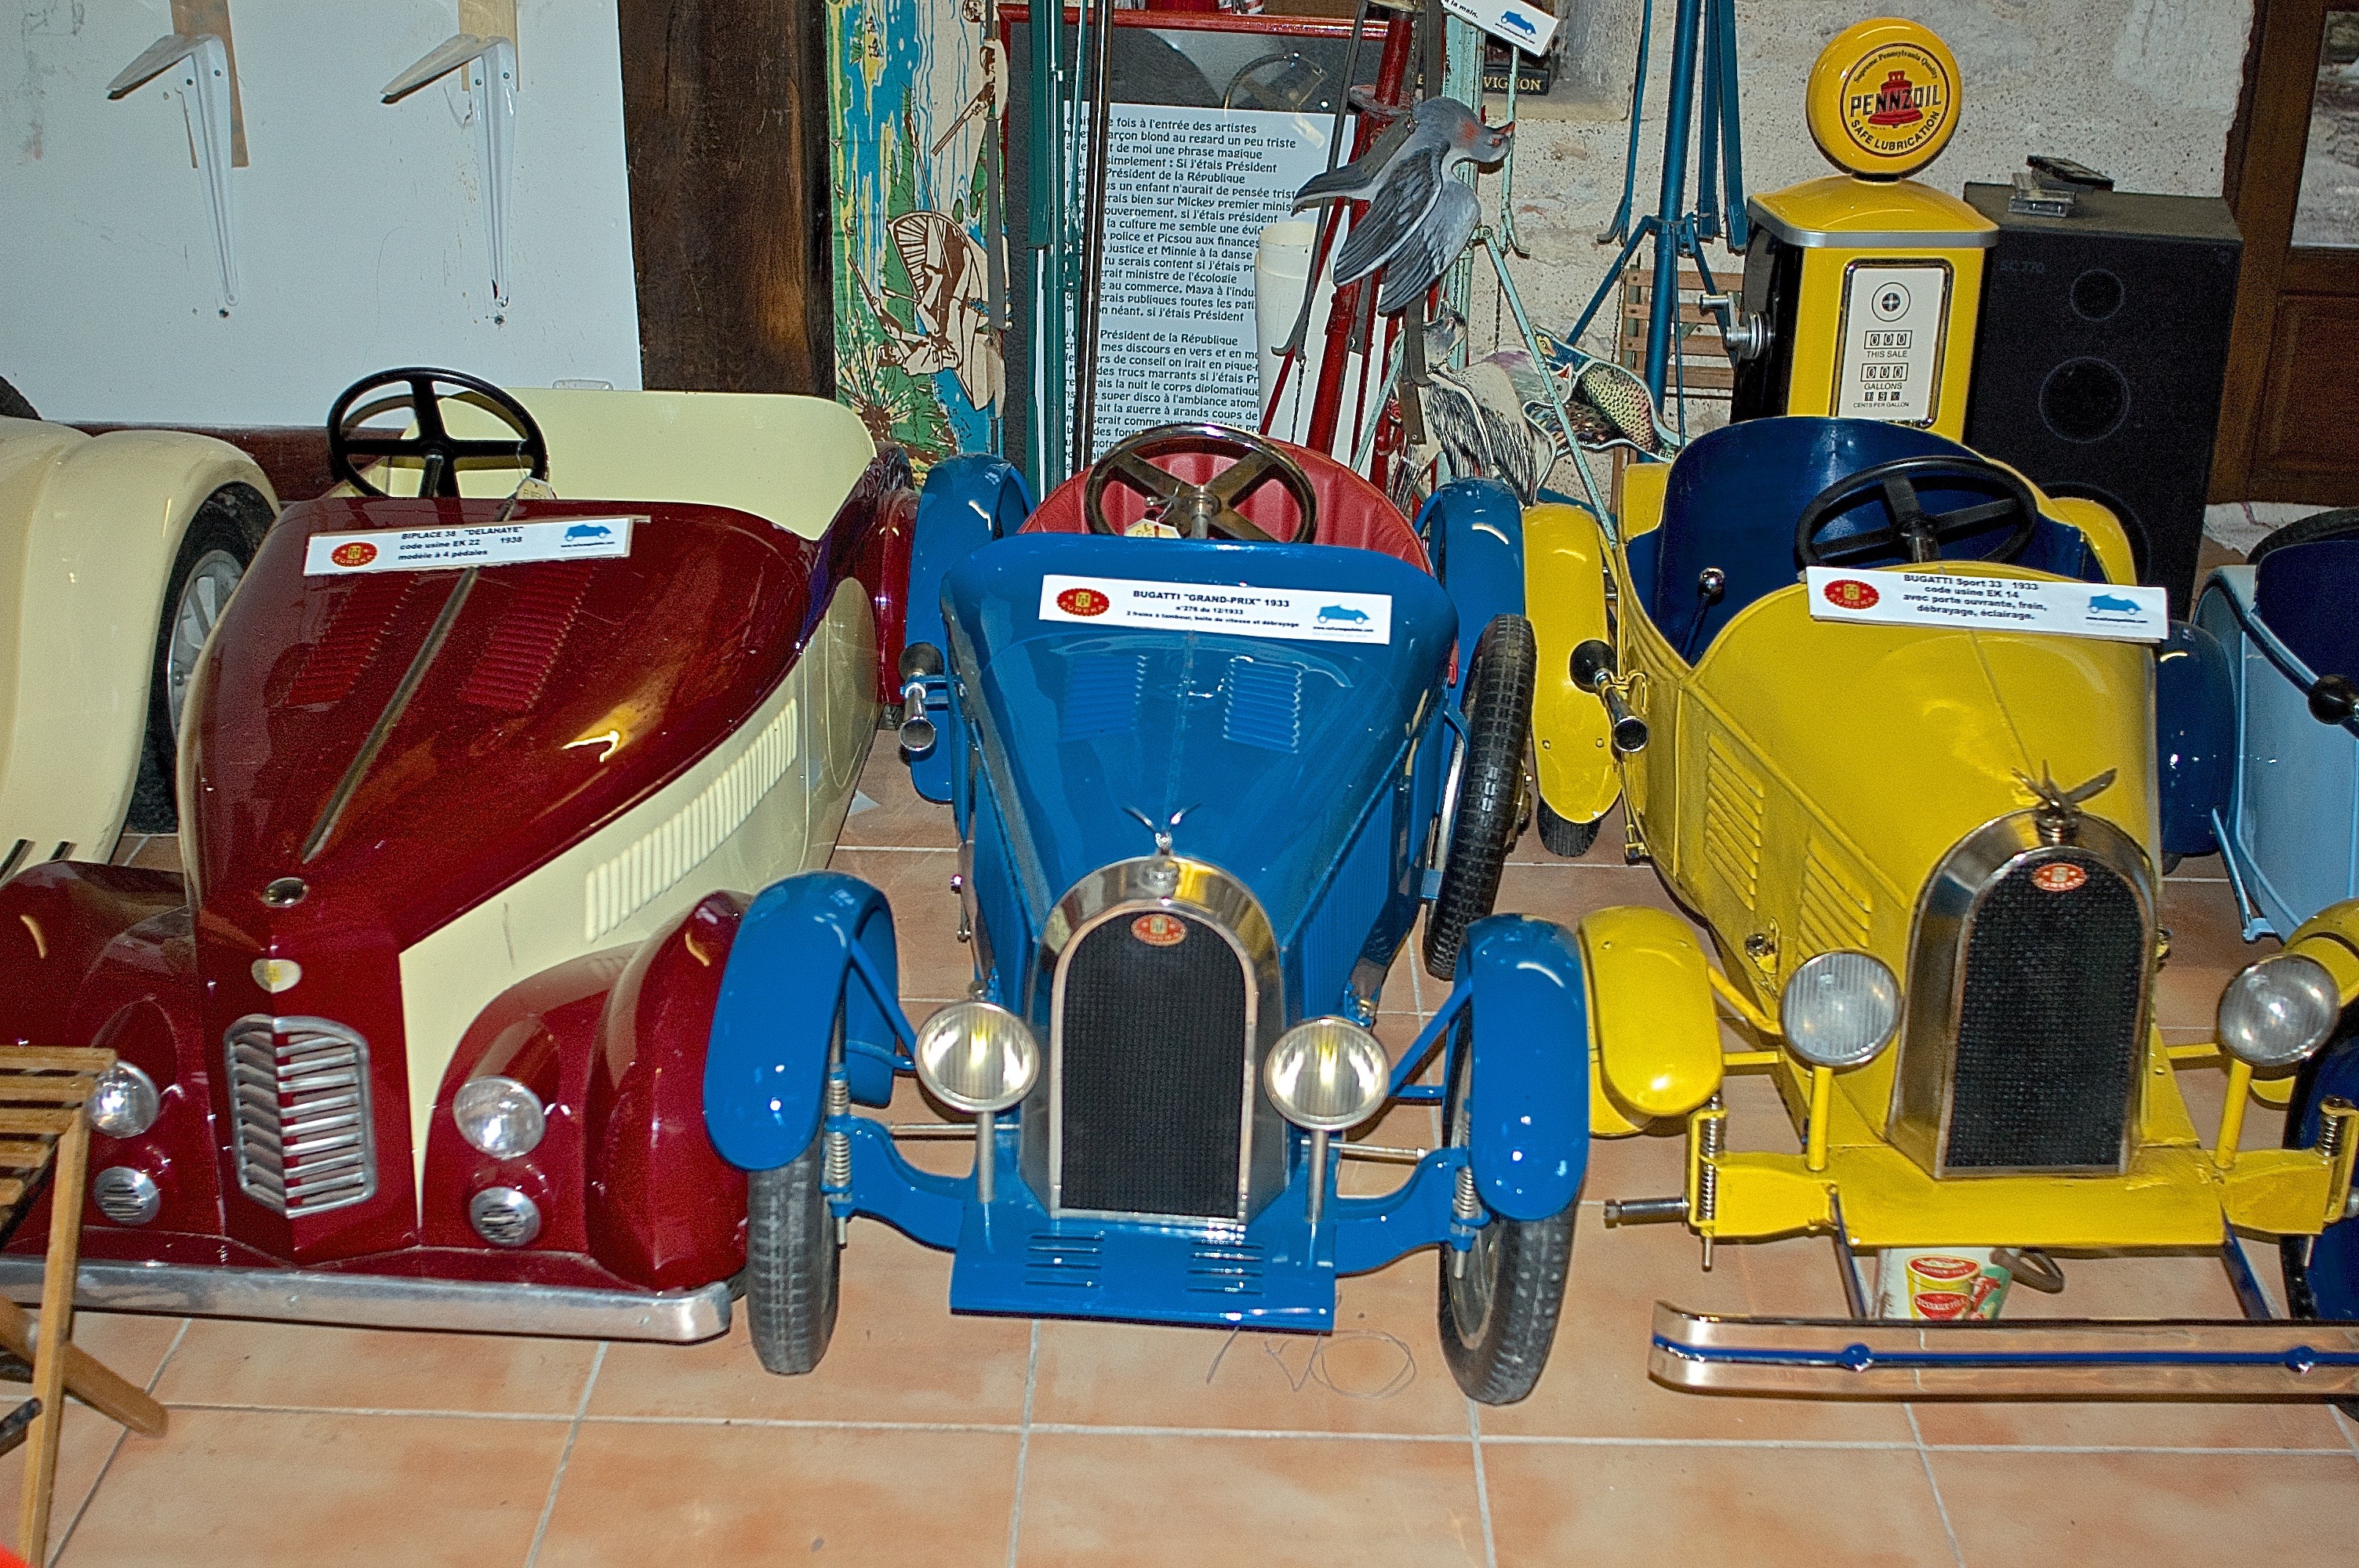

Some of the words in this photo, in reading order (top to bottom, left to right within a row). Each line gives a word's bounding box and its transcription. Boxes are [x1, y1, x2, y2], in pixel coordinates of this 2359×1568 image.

[1853, 59, 1878, 83] Supreme
[1878, 49, 1921, 62] Pennsylvania
[1921, 57, 1939, 79] Quality
[1849, 84, 1942, 117] PENNZOIL
[1116, 117, 1136, 127] fois
[1140, 118, 1146, 128] à
[1149, 118, 1189, 130] l'entrée
[1192, 121, 1211, 131] des
[1215, 122, 1256, 133] artistes
[1850, 118, 1874, 144] SAFE
[1874, 111, 1940, 151] LUBRICATION
[1140, 131, 1169, 141] blond
[1189, 134, 1224, 144] regard
[1244, 137, 1263, 146] peu
[1267, 137, 1296, 148] triste
[1116, 142, 1129, 152] de
[1132, 143, 1151, 154] moi
[1155, 146, 1174, 154] une
[1178, 145, 1214, 157] phrase
[1217, 148, 1262, 159] magique
[1107, 155, 1166, 167] simplement
[1176, 158, 1187, 168] Si
[1190, 158, 1222, 169] j'étais
[1226, 161, 1277, 172] Président
[1106, 168, 1155, 179] Président
[1158, 170, 1171, 180] de
[1174, 170, 1183, 180] la
[1187, 171, 1245, 183] République
[1135, 182, 1169, 192] enfant
[1172, 183, 1212, 194] n'aurait
[1216, 185, 1228, 195] de
[1232, 187, 1269, 198] pensée
[1131, 194, 1153, 204] bien
[1156, 197, 1174, 205] sur
[1177, 196, 1215, 207] Mickey
[1218, 199, 1259, 209] premier
[1180, 209, 1189, 219] si
[1192, 209, 1224, 220] j'étais
[1228, 211, 1278, 223] président
[1107, 217, 1115, 227] la
[1119, 219, 1156, 229] culture
[1159, 222, 1176, 230] me
[1179, 222, 1216, 232] semble
[1219, 225, 1238, 234] une
[1110, 230, 1140, 241] police
[1143, 233, 1154, 241] et
[1157, 233, 1192, 244] Picsou
[1195, 236, 1214, 245] aux
[1217, 236, 1259, 248] finances
[1108, 242, 1143, 254] justice
[1147, 245, 1158, 254] et
[1161, 245, 1196, 256] Minnie
[1199, 247, 1205, 256] à
[1209, 247, 1217, 257] la
[1221, 249, 1252, 260] danse
[1104, 256, 1114, 265] tu
[1118, 256, 1150, 267] serais
[1153, 259, 1193, 268] content
[1196, 260, 1205, 269] si
[1208, 260, 1240, 271] j'étais
[1125, 269, 1169, 280] ministre
[1172, 270, 1185, 281] de
[1188, 271, 1237, 283] l'écologie
[1109, 281, 1121, 290] au
[1185, 284, 1213, 295] Maya
[1216, 285, 1223, 295] à
[1127, 294, 1176, 305] publiques
[1180, 296, 1212, 307] toutes
[1216, 298, 1231, 308] les
[1147, 307, 1155, 317] si
[1158, 307, 1190, 318] j'étais
[1194, 309, 1244, 321] Président
[1100, 329, 1150, 340] Président
[1153, 332, 1165, 341] de
[1169, 332, 1177, 342] la
[1181, 333, 1238, 346] République
[1125, 343, 1170, 354] discours
[1189, 347, 1212, 356] vers
[1215, 348, 1226, 357] et
[1113, 354, 1125, 364] de
[1129, 356, 1165, 365] conseil
[1169, 358, 1181, 367] on
[1184, 358, 1205, 368] irait
[1096, 365, 1114, 376] des
[1118, 367, 1144, 377] trucs
[1148, 369, 1196, 379] marrants
[1199, 371, 1209, 381] si
[1211, 371, 1243, 383] j'étais
[1115, 379, 1124, 388] la
[1128, 379, 1147, 389] nuit
[1150, 380, 1160, 390] le
[1163, 383, 1191, 392] corps
[1194, 383, 1259, 397] diplomatique
[1864, 382, 1903, 390] GALLONS
[1133, 391, 1161, 402] disco
[1163, 393, 1169, 402] à
[1172, 394, 1227, 406] l'ambiance
[1125, 405, 1161, 414] guerre
[1173, 408, 1209, 417] grands
[1212, 410, 1241, 419] coups
[1245, 410, 1257, 420] de
[1093, 426, 1110, 437] des
[402, 531, 442, 539] BIPLACE
[451, 549, 488, 558] pédales
[1904, 575, 1953, 584] BUGATTI
[1956, 578, 1986, 587] Sport
[2012, 582, 2039, 590] 1933
[1133, 590, 1180, 600] BUGATTI
[1183, 593, 1261, 605] "GRAND-PRIX"
[1264, 599, 1289, 608] 1933
[1917, 604, 1978, 617] débrayage,
